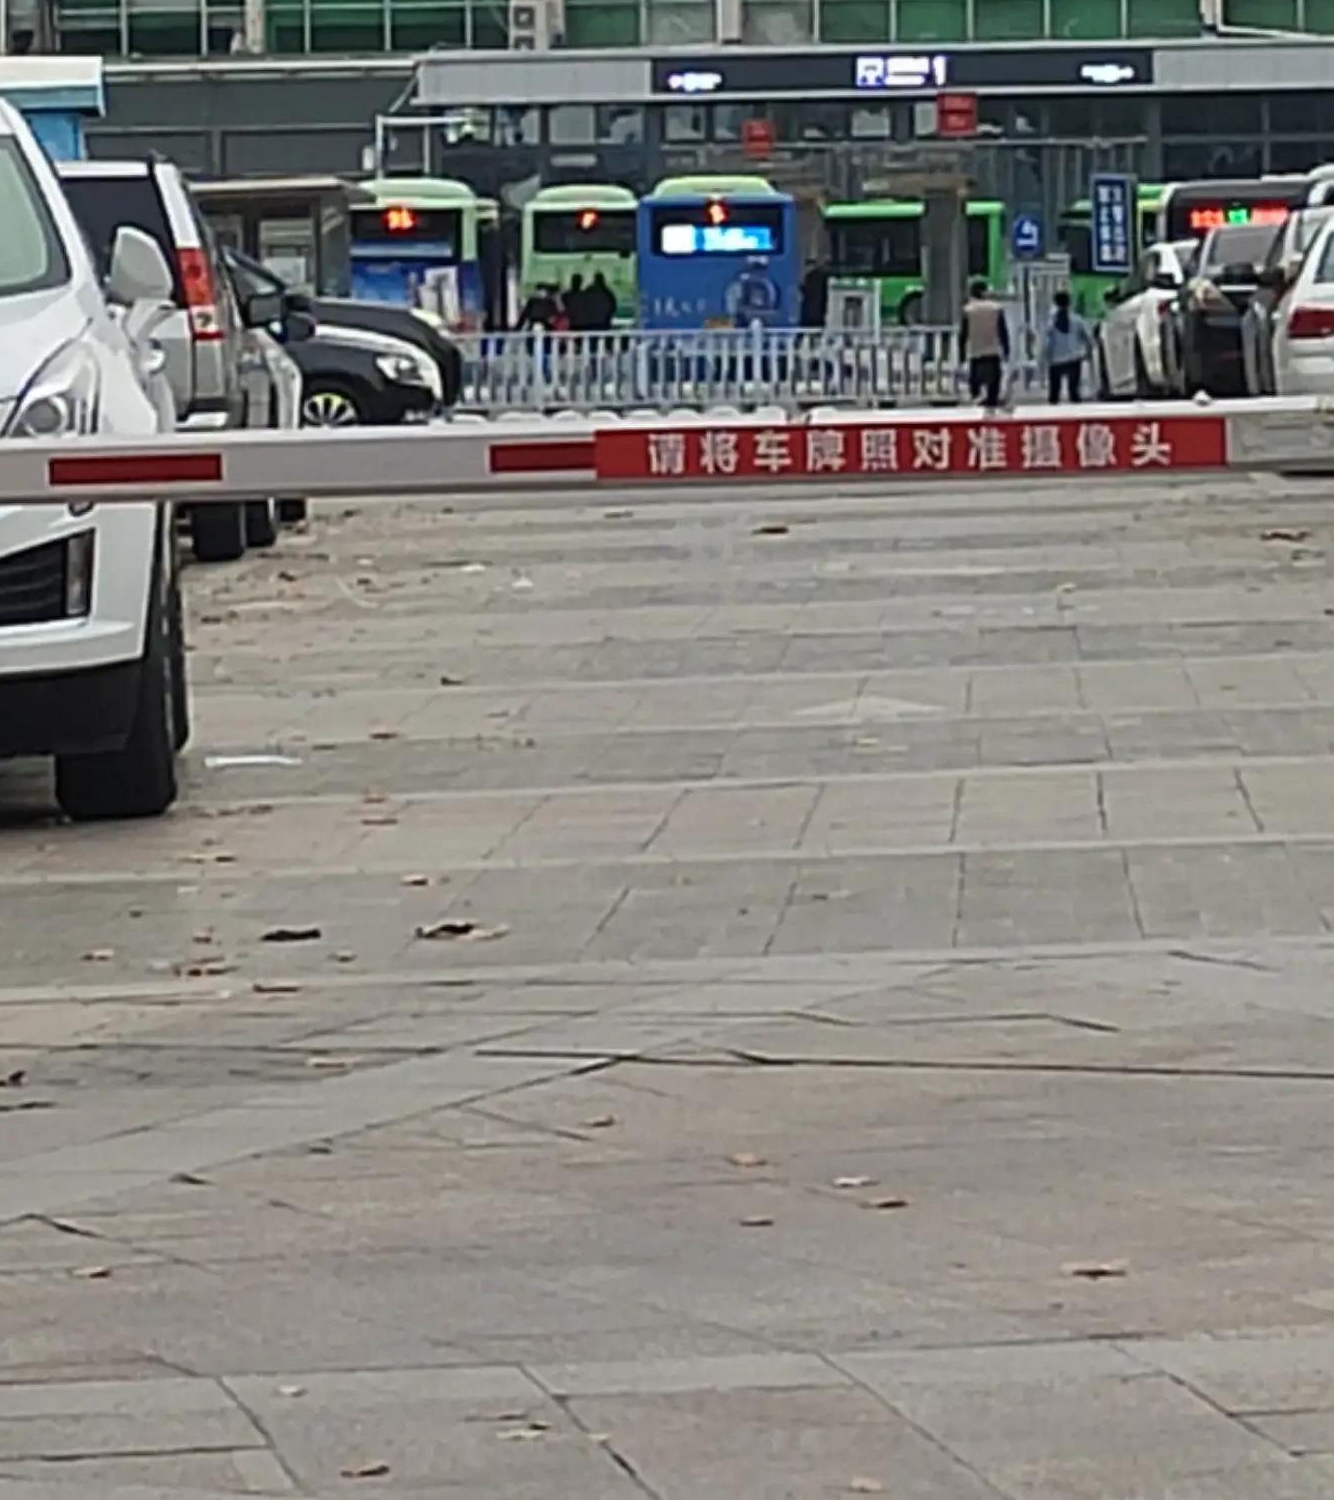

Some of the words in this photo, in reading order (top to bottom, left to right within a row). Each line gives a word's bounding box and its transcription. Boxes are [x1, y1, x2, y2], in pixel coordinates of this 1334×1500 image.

[647, 423, 1173, 476] 请将车牌照对准摄像头
